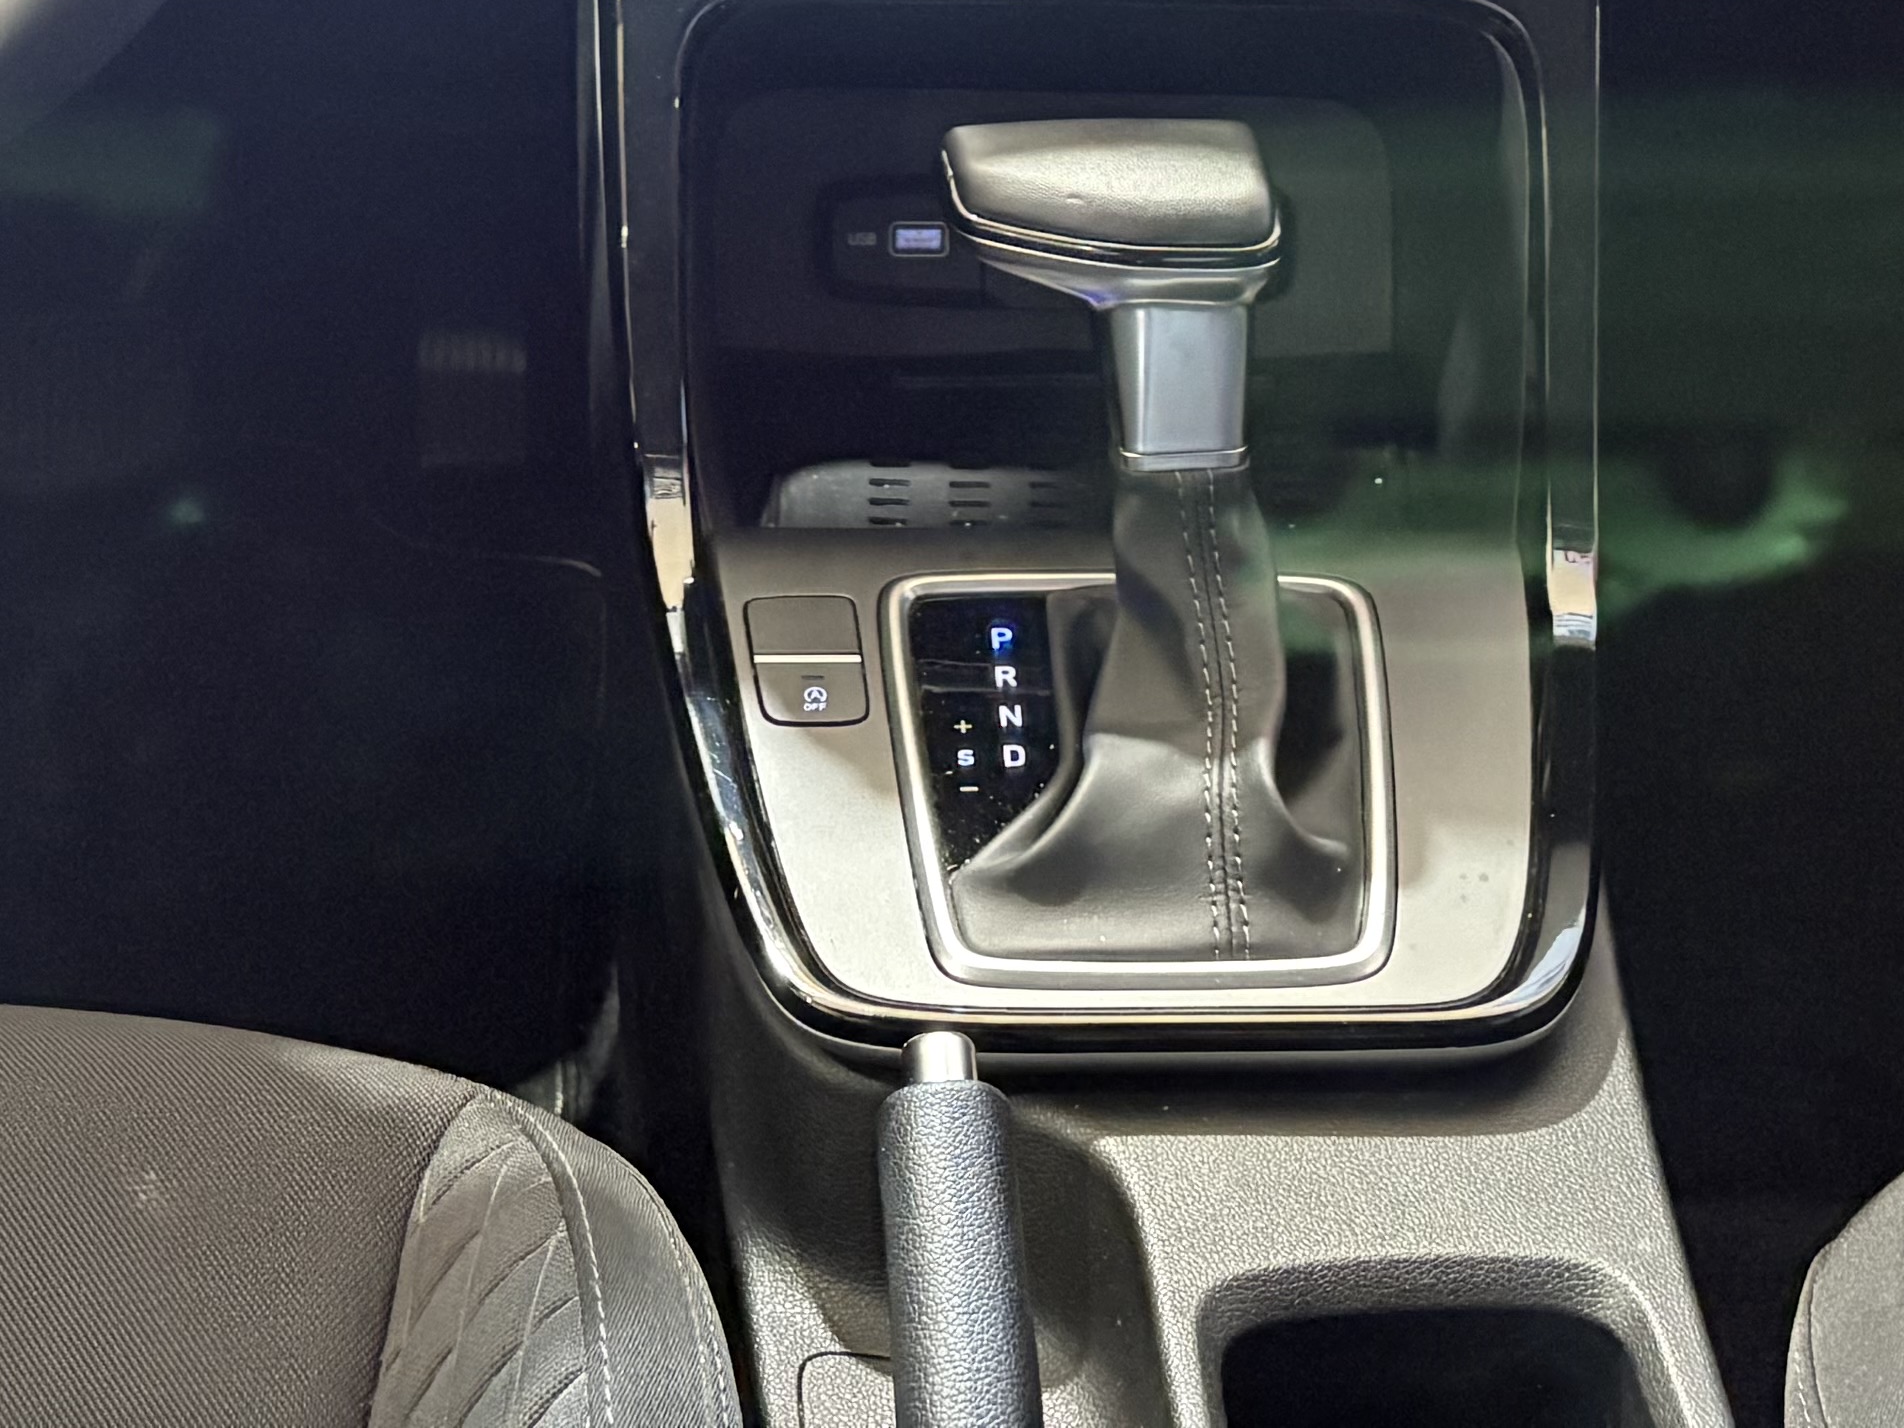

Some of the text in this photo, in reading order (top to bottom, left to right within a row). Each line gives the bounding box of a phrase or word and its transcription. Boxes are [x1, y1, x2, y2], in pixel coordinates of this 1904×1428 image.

[990, 626, 1013, 650] P
[994, 665, 1018, 688] R
[803, 702, 827, 712] OFF
[998, 704, 1023, 728] N
[956, 748, 975, 767] S
[1003, 744, 1026, 768] D
